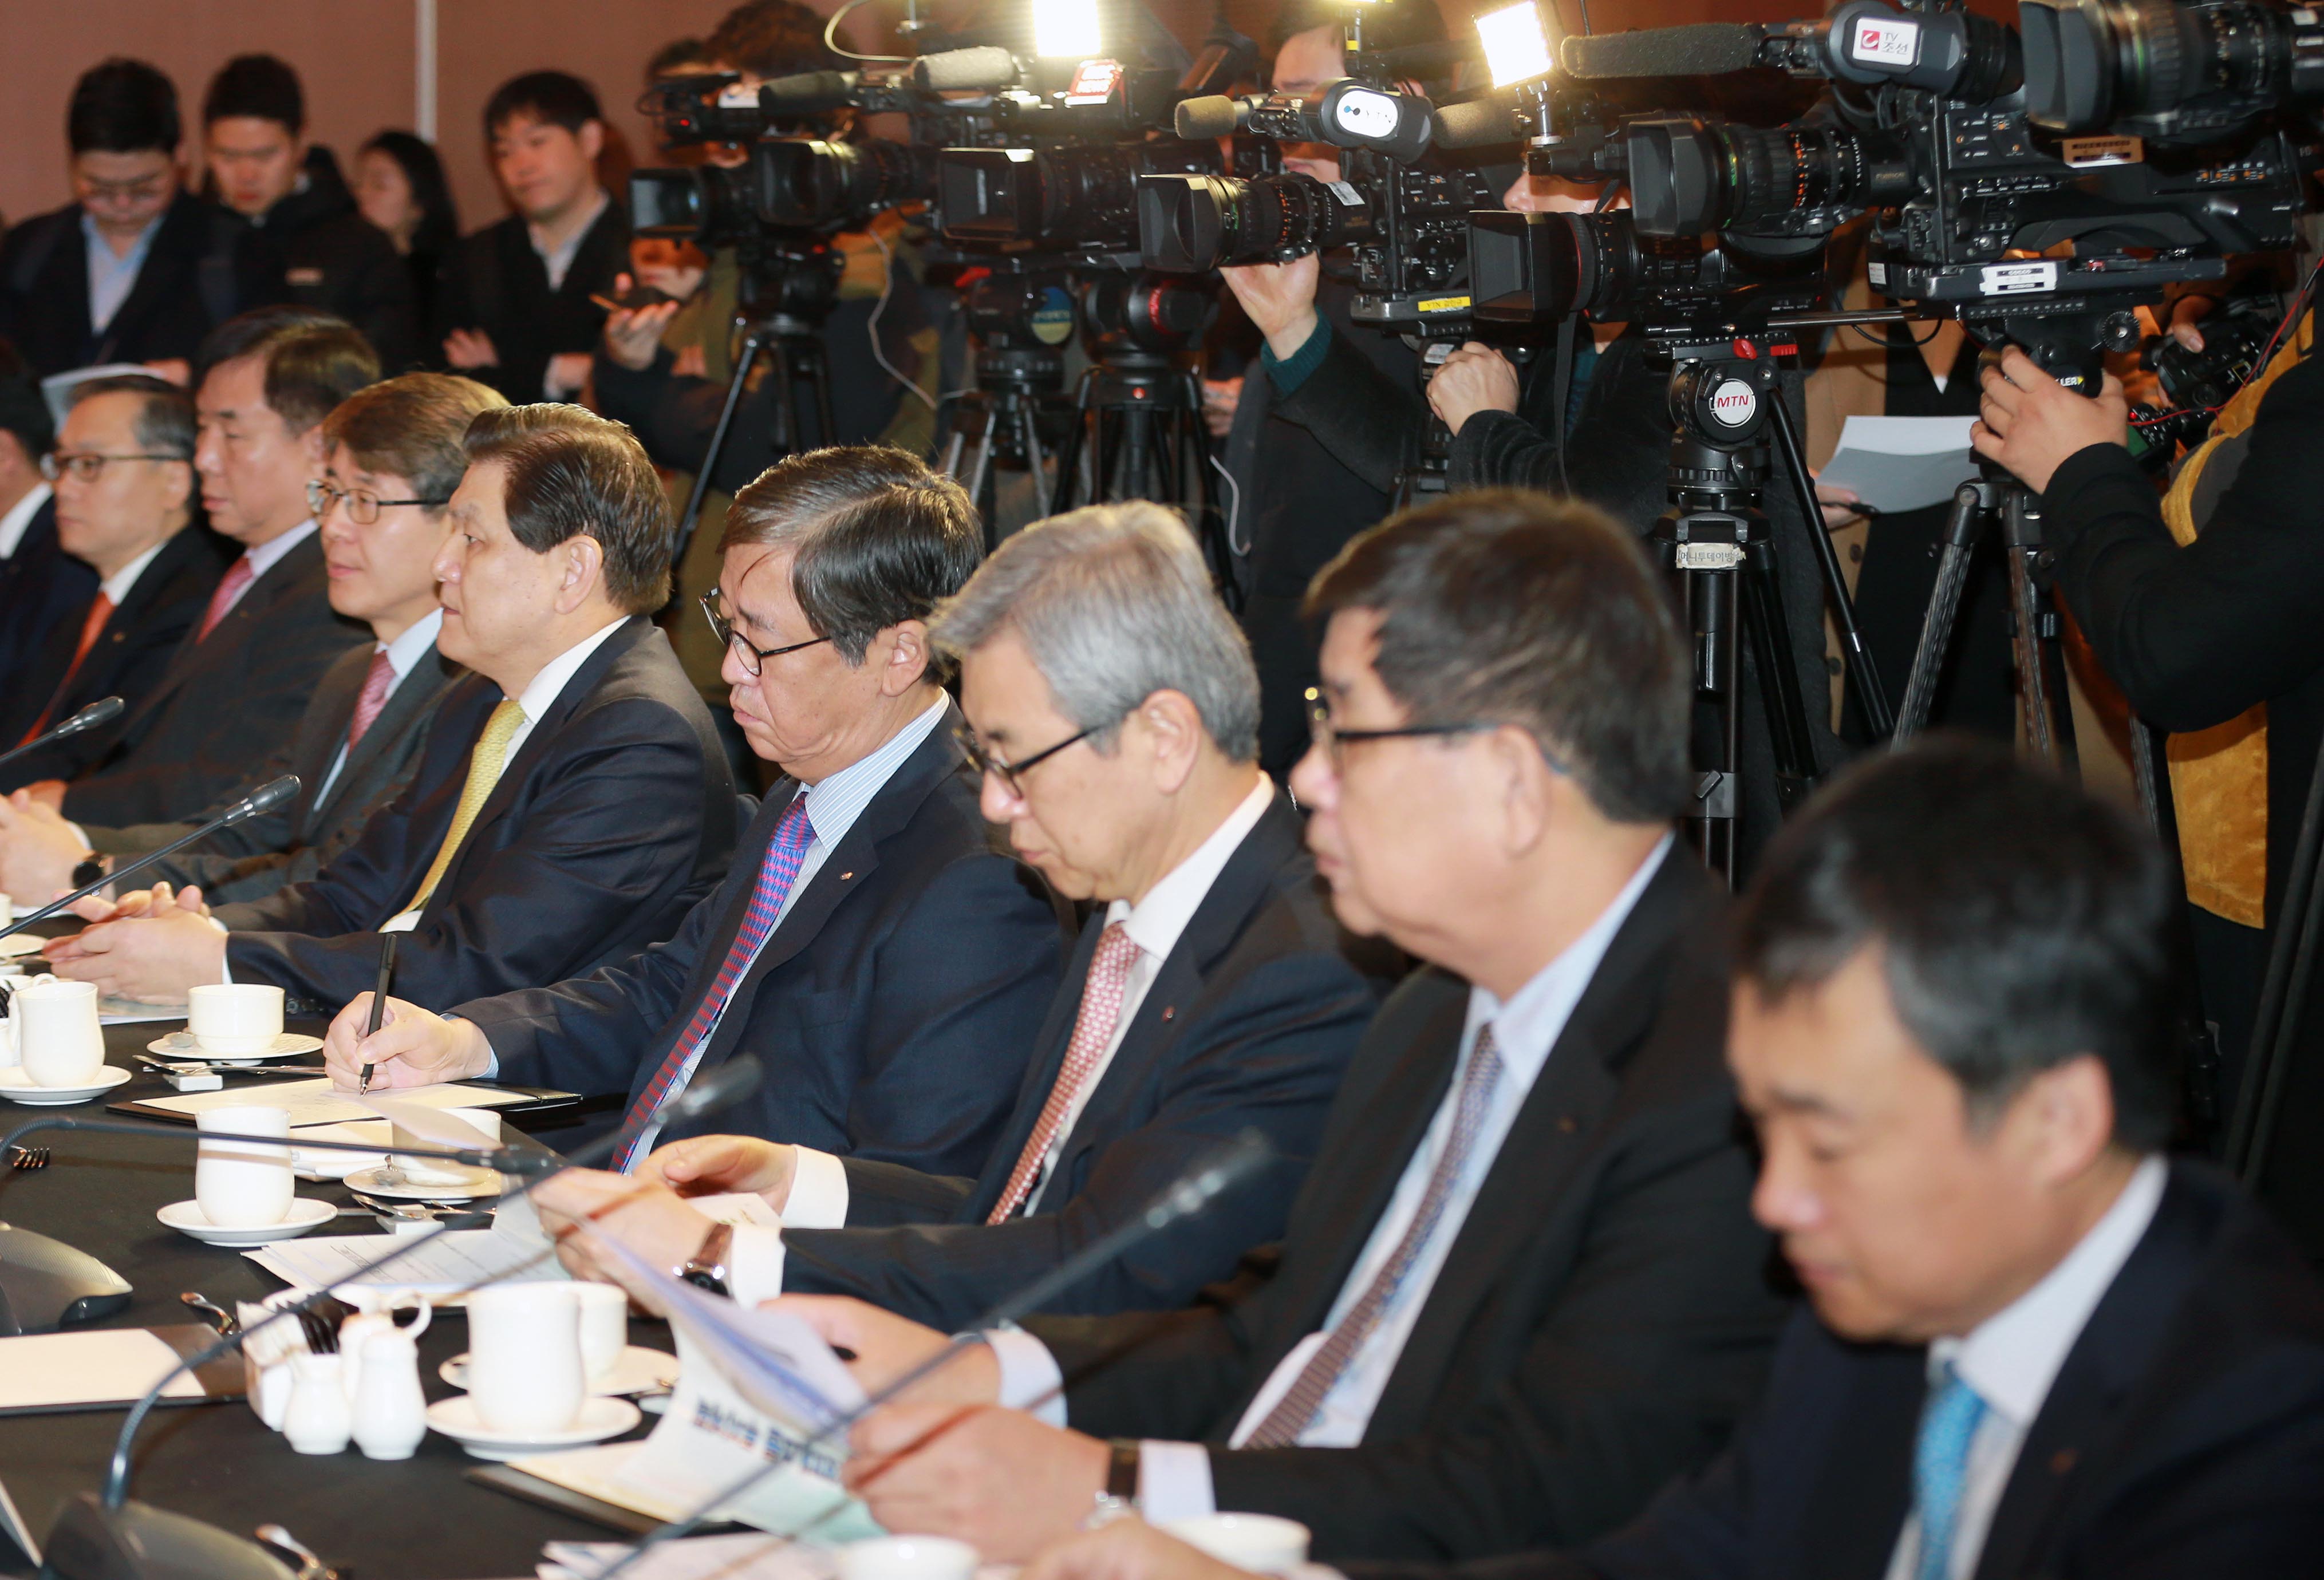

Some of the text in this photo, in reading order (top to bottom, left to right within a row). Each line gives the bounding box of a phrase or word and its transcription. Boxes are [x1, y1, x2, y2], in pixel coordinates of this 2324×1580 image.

[1884, 32, 1899, 42] TV
[1881, 42, 1908, 55] 조선
[1366, 109, 1395, 124] YTN
[1718, 395, 1749, 408] MTN
